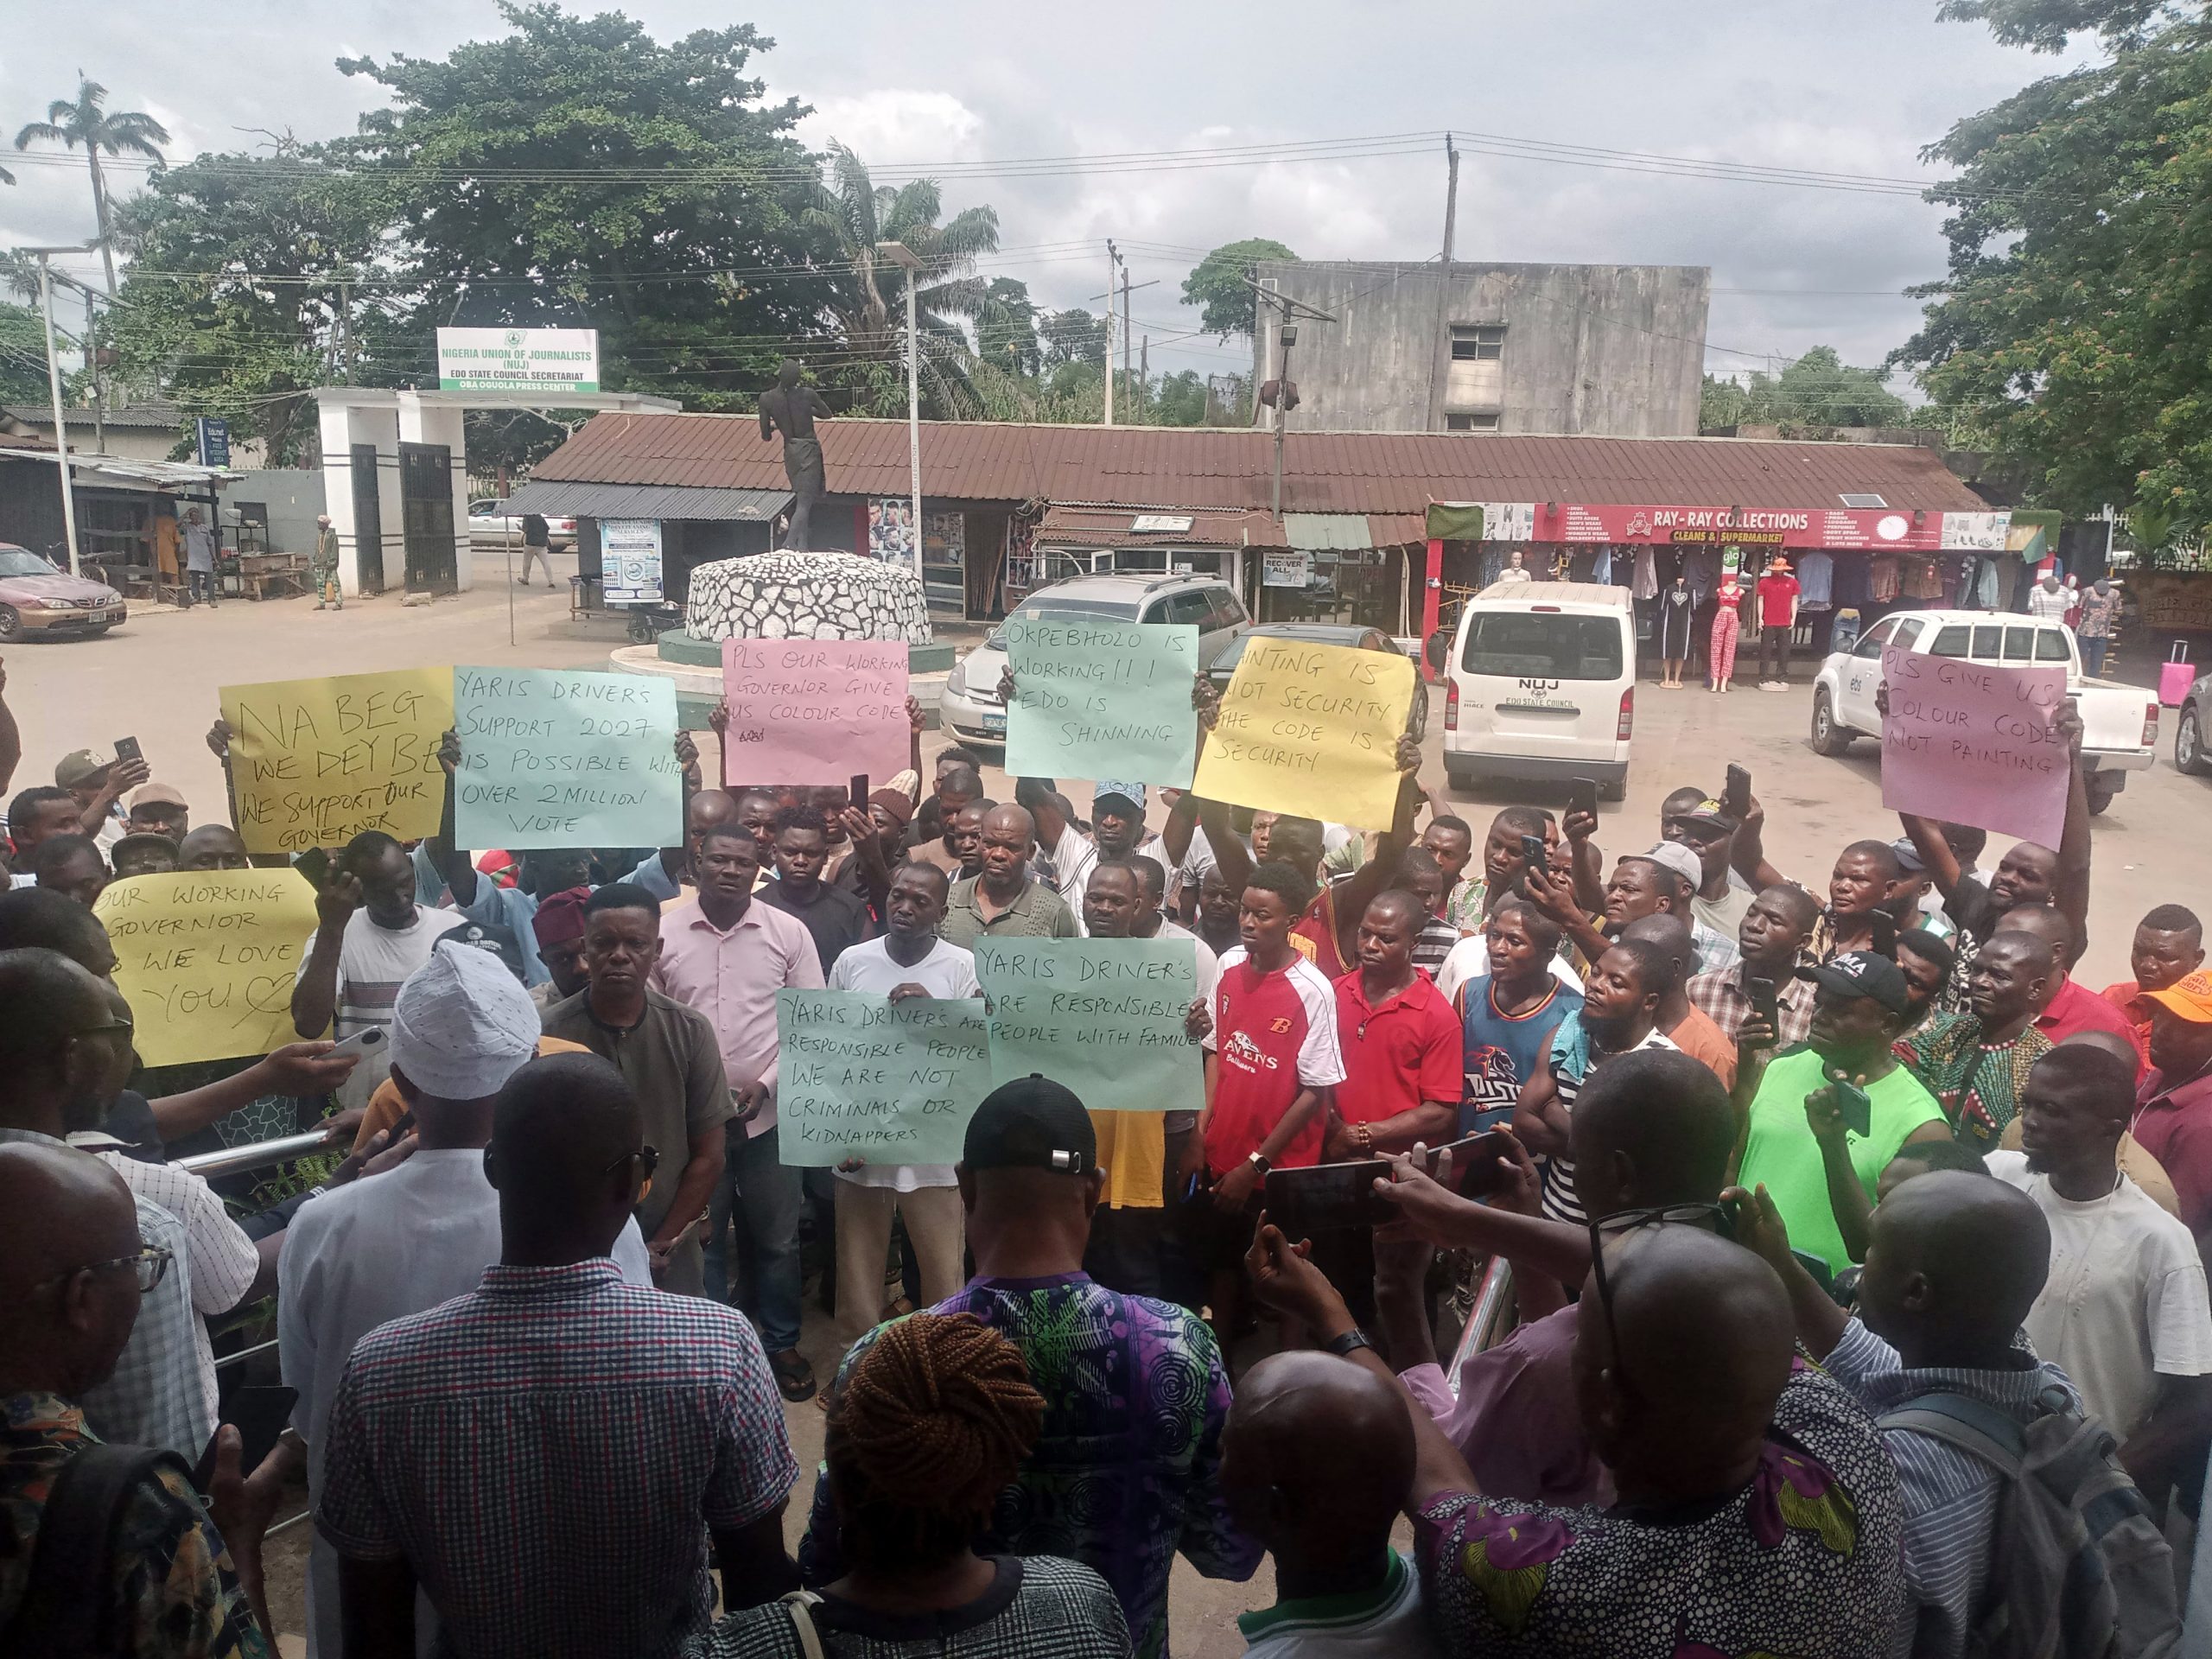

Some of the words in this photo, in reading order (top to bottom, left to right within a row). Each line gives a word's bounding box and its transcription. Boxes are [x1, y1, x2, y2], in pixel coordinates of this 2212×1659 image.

[442, 348, 480, 359] NIGERIA
[481, 349, 512, 359] UNION
[514, 350, 525, 359] OF
[528, 350, 592, 361] JOURNALISTS
[503, 360, 530, 370] (NUJ)
[450, 370, 467, 378] EDO
[468, 370, 492, 378] STATE
[493, 371, 529, 379] COUNCIL
[531, 372, 584, 381] SECRETARIAT
[480, 381, 515, 390] OGUOLA
[543, 383, 576, 391] CENTER
[1716, 512, 1808, 530] COLLECTIONS
[1674, 531, 1706, 542] CLEANS
[1708, 532, 1715, 541] &
[1720, 531, 1784, 543] SUPERMARKET
[1723, 548, 1740, 564] glo
[1165, 635, 1186, 652] IS
[733, 644, 766, 670] PLS
[781, 651, 829, 670] OUR
[1349, 663, 1380, 685] IS
[1886, 650, 1921, 678] PLS
[1937, 664, 1993, 691] GIVE
[458, 671, 531, 698] YARIS
[736, 676, 830, 696] GOVERNOR
[845, 678, 893, 696] GIVE
[1519, 678, 1559, 690] NUJ
[731, 704, 753, 720] US
[769, 703, 841, 721] COLOUR
[855, 705, 901, 720] CODE
[1021, 690, 1069, 710] EDO
[1086, 696, 1107, 712] IS
[1280, 686, 1391, 721] SECURITY
[1546, 699, 1574, 709] COUNCIL
[239, 702, 319, 751] NA
[336, 690, 424, 735] BEG
[461, 705, 556, 737] SUPPORT
[580, 717, 654, 739] 2027
[1889, 688, 1970, 728] COLOUR
[1994, 714, 2058, 744] CODE
[1058, 722, 1175, 747] SHINNING
[1218, 708, 1252, 728] THE
[1272, 720, 1324, 741] CODE
[1350, 731, 1373, 750] IS
[254, 756, 302, 783] WE
[317, 734, 380, 779] DEY
[1213, 738, 1320, 772] SECURITY
[1888, 728, 1932, 752] NOT
[1951, 740, 2053, 772] PAINTING
[465, 753, 490, 771] IS
[511, 749, 631, 772] POSSIBLE
[649, 754, 683, 778] WITH
[242, 793, 275, 824] WE
[283, 787, 382, 828] SUPPORT
[383, 780, 429, 806] OUR
[461, 785, 518, 804] OVER
[508, 814, 579, 833] VOTE
[91, 887, 150, 913] OUR
[173, 883, 287, 904] WORKING
[109, 912, 261, 938] GOVERNOR
[143, 948, 196, 971] WE
[216, 944, 295, 965] LOVE
[979, 947, 1056, 979] YARIS
[1079, 956, 1192, 982] DRIVER'S
[142, 982, 232, 1023] YOU
[782, 995, 847, 1027] YARIS
[959, 1016, 987, 1031] ARE
[983, 993, 1027, 1013] ARE
[1051, 993, 1190, 1017] RESPONSIBLE
[990, 1021, 1061, 1042] PEOPLE
[1077, 1028, 1130, 1045] WITH
[789, 1033, 906, 1059] RESPONSIBLE
[927, 1039, 987, 1061] PEOPLE
[791, 1063, 826, 1087] WE
[842, 1068, 887, 1084] ARE
[909, 1067, 960, 1088] NOT
[1464, 1072, 1524, 1102] PIST
[789, 1096, 899, 1118] CRIMINALS
[922, 1099, 957, 1115] OR
[802, 1122, 918, 1145] KIDNAPPERS
